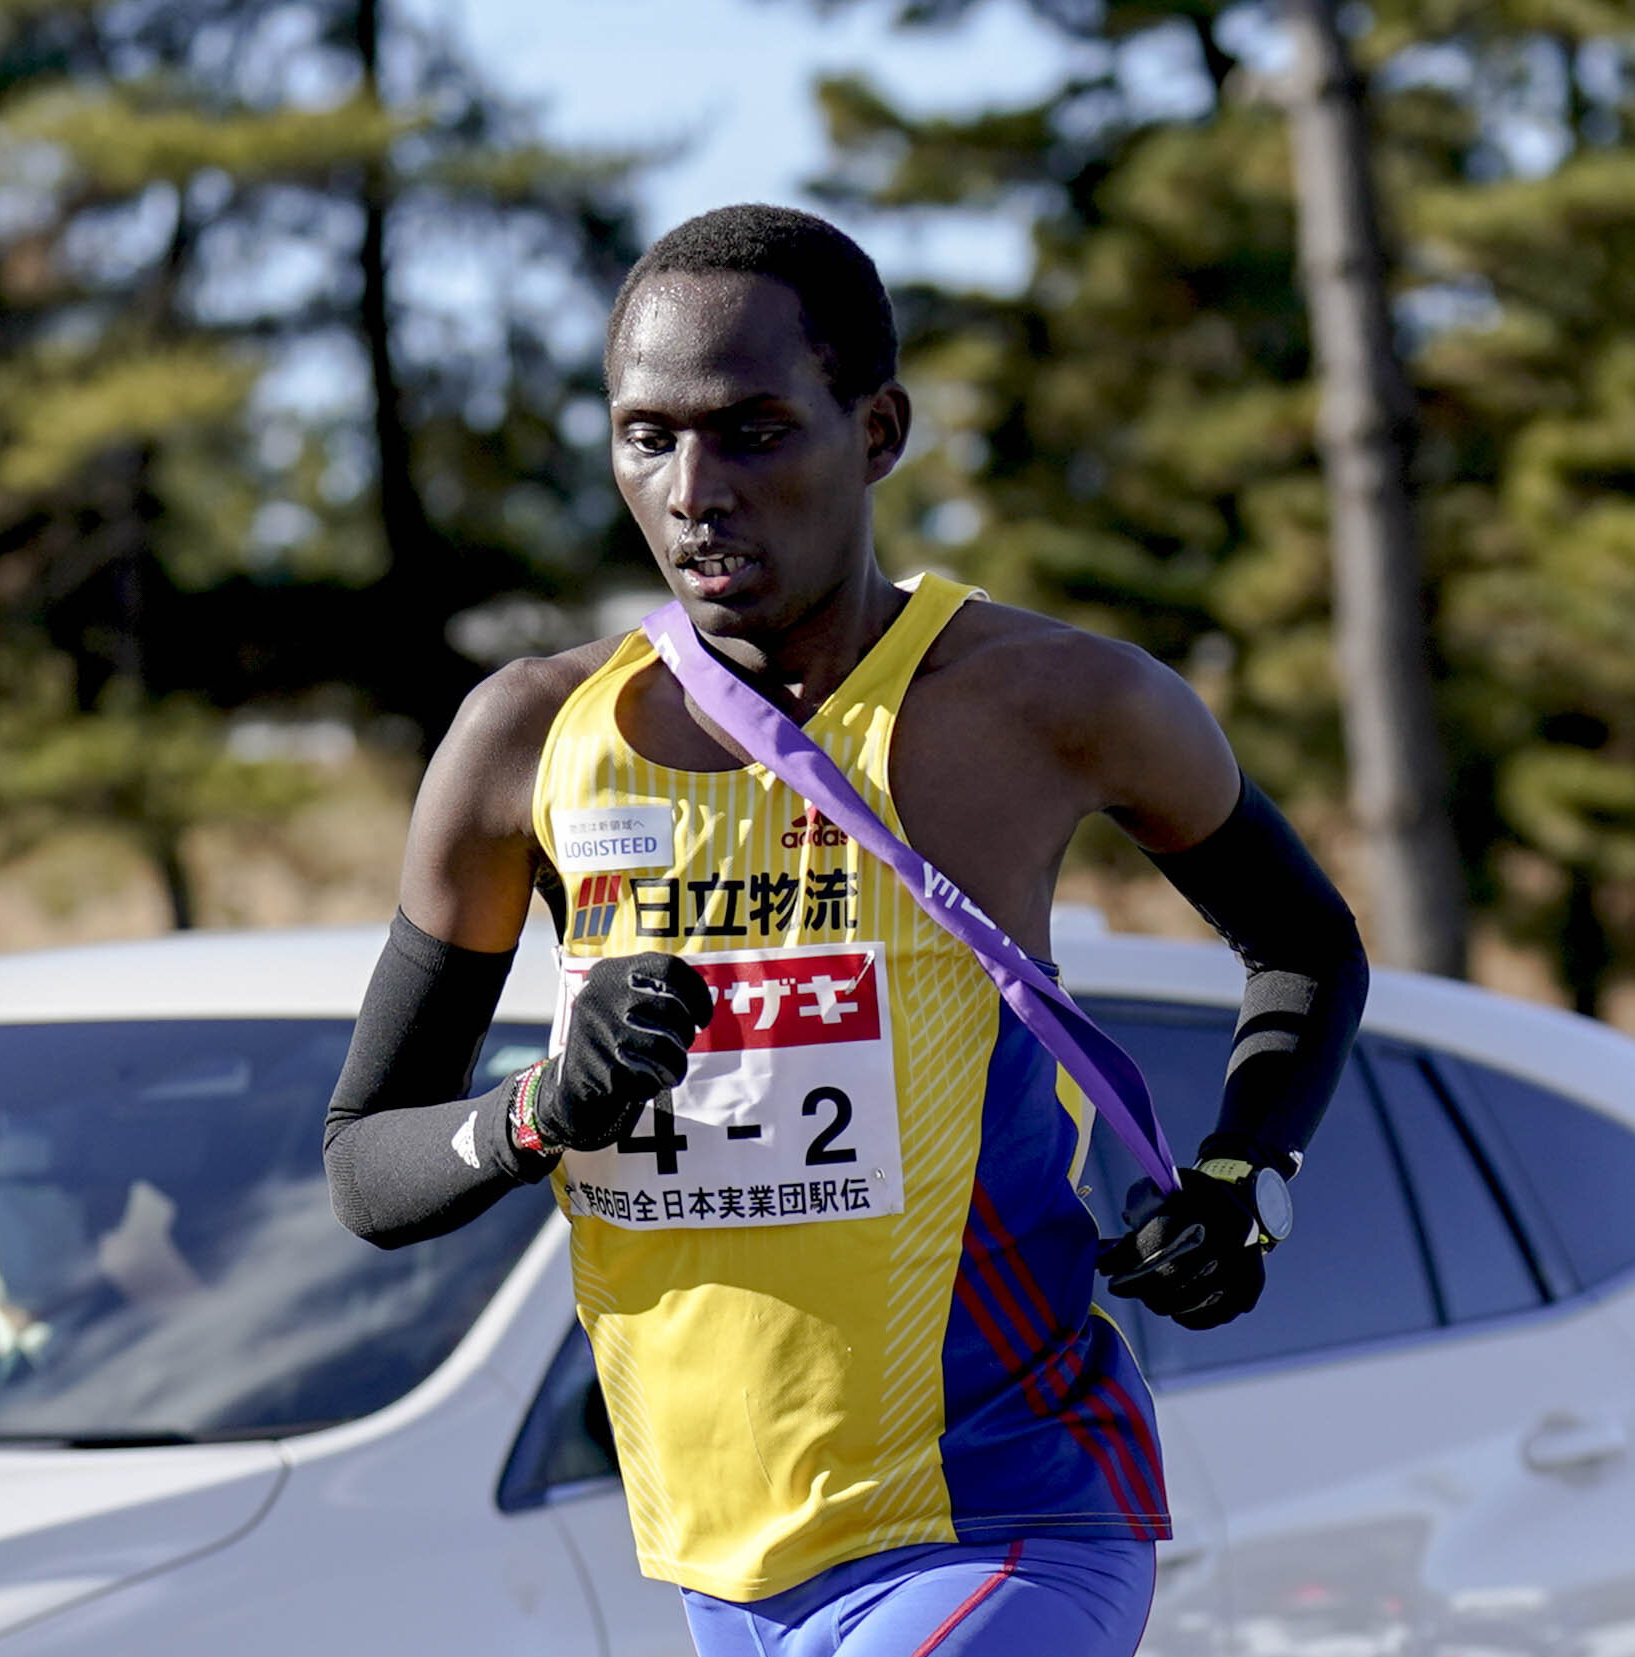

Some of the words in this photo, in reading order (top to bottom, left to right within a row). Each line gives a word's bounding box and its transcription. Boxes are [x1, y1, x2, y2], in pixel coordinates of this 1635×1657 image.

[565, 836, 658, 858] LOGISTEED
[630, 868, 859, 938] 日立物流
[579, 1177, 871, 1222] 第66回全日本実業団駅伝
